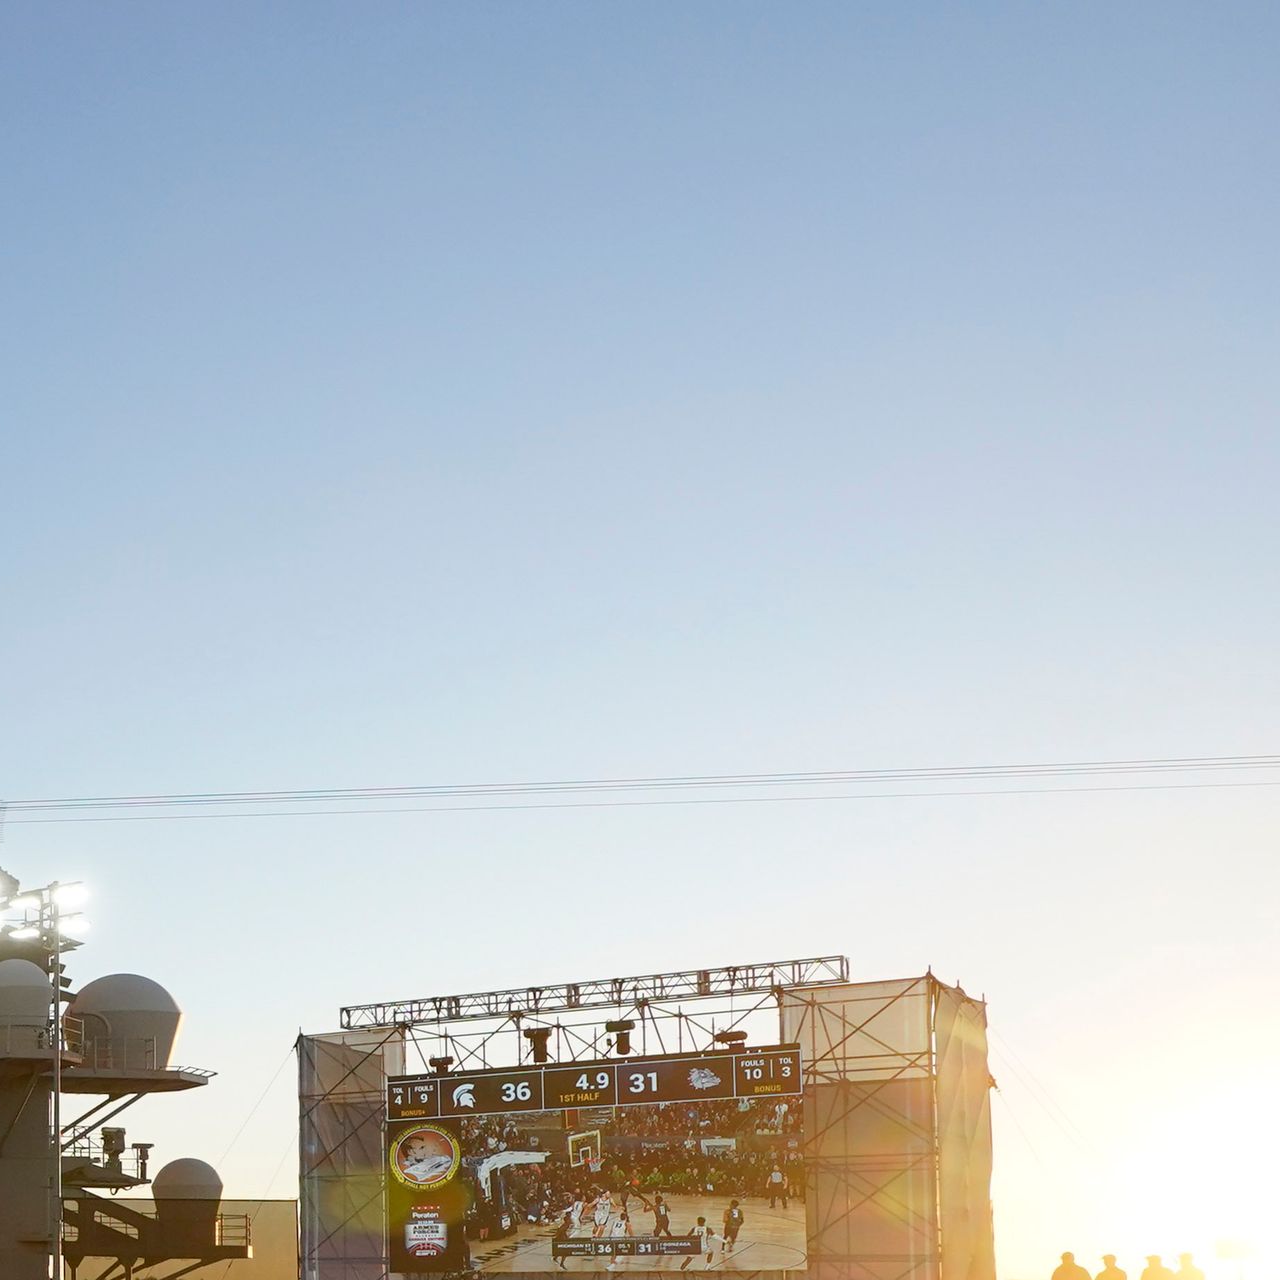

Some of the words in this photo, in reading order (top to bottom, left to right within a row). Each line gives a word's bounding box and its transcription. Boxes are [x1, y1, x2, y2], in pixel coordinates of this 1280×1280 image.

[740, 1059, 765, 1068] FOULS
[778, 1057, 793, 1065] TOL
[744, 1068, 763, 1080] 10
[781, 1066, 792, 1078] 3
[576, 1071, 609, 1091] 4.9
[629, 1072, 658, 1093] 31
[414, 1085, 434, 1093] FOULS
[501, 1082, 532, 1102] 36
[754, 1084, 782, 1093] BONUS
[394, 1095, 403, 1105] 4
[419, 1093, 429, 1104] 9
[559, 1094, 574, 1103] 1ST
[577, 1092, 600, 1102] HALF
[598, 1244, 613, 1254] 36
[638, 1243, 652, 1253] 31
